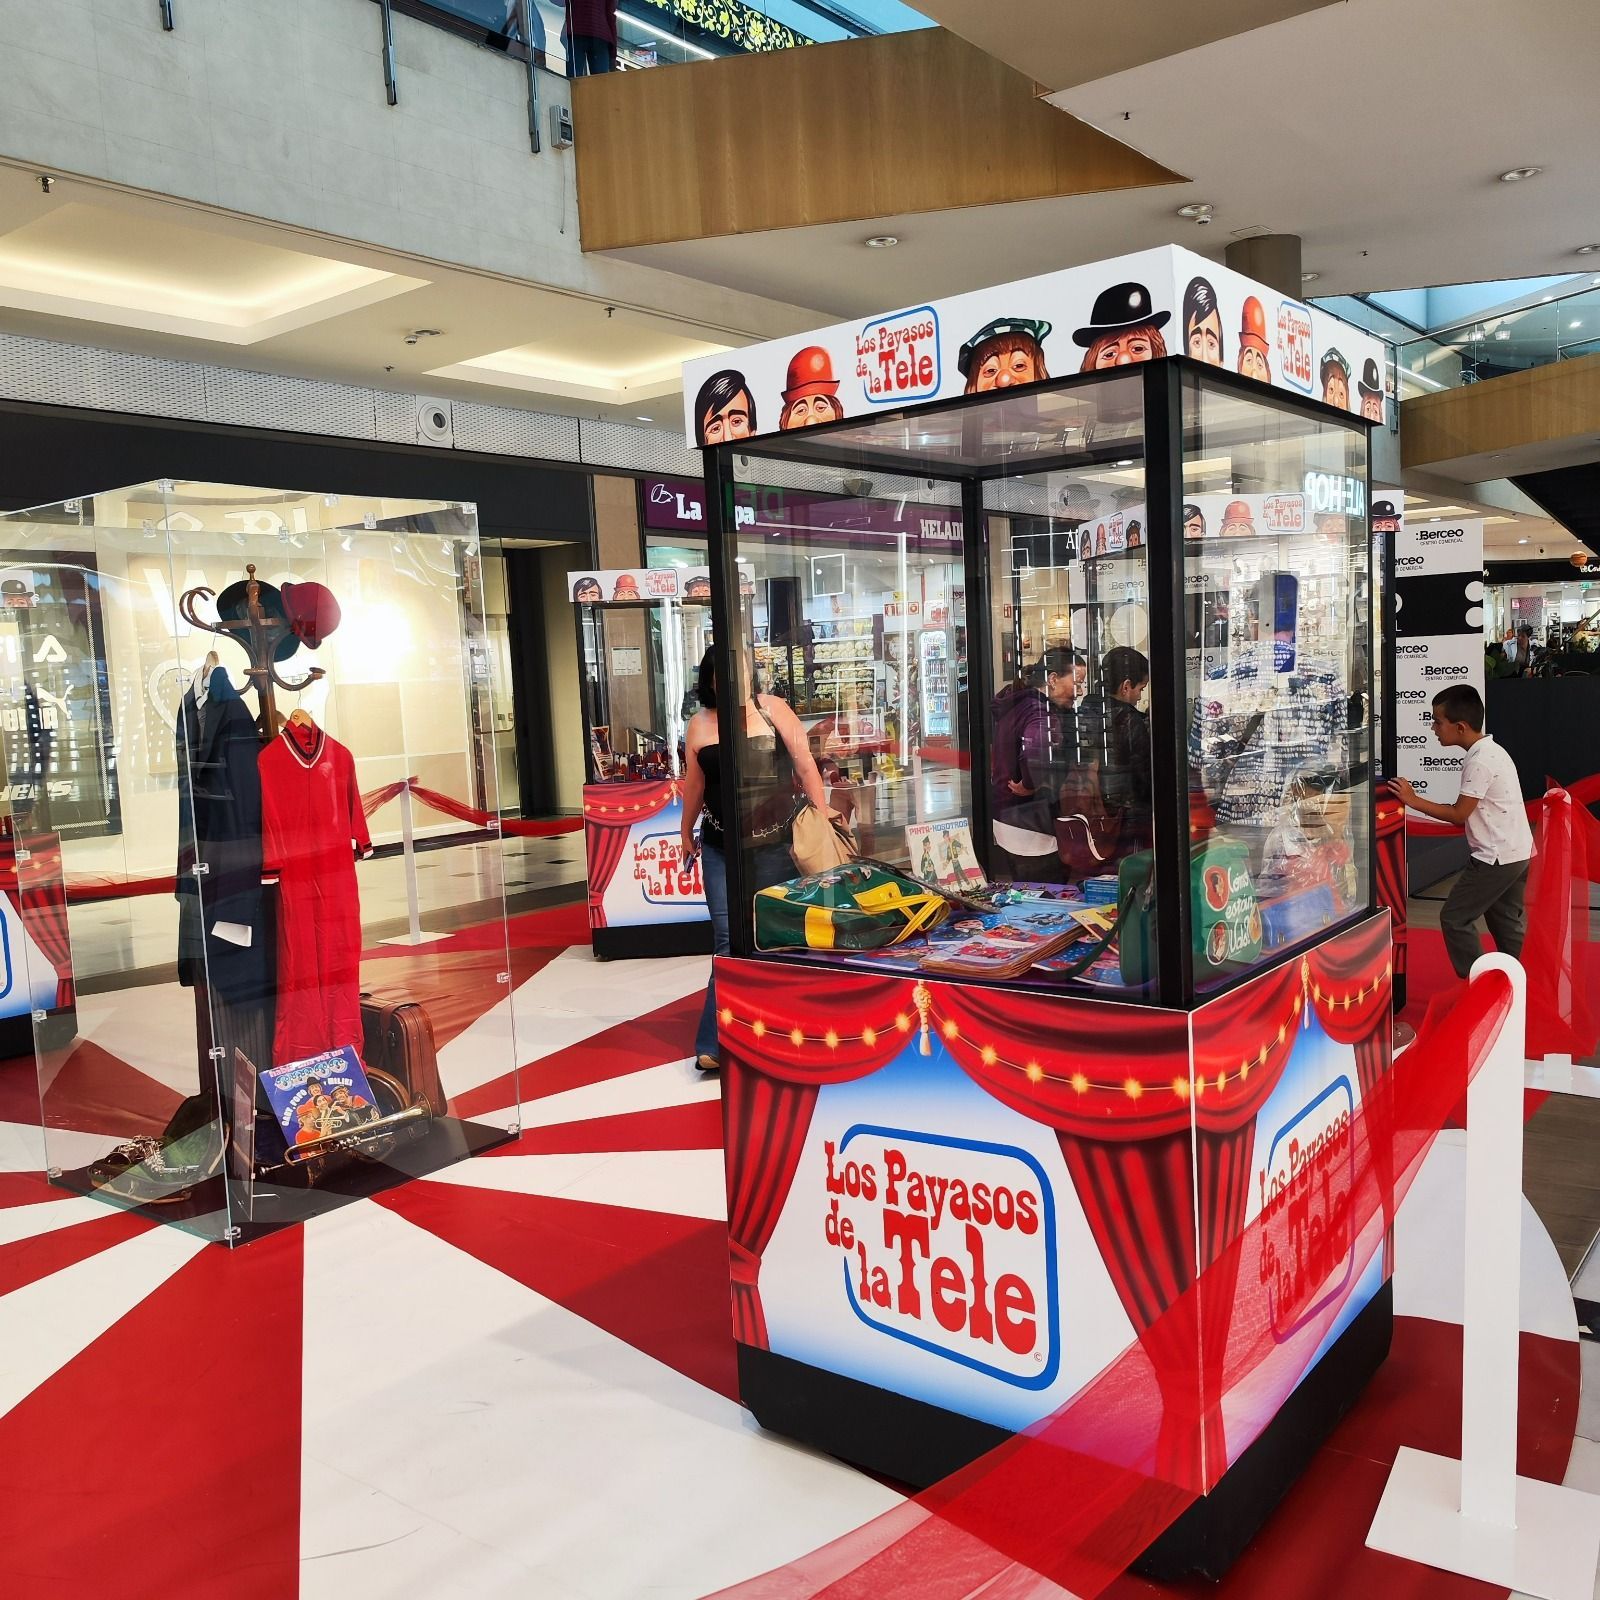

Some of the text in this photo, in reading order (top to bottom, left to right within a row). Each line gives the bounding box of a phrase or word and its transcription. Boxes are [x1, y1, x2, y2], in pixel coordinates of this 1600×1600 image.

[856, 321, 934, 355] Los Payasos
[1288, 333, 1311, 382] Tele
[856, 358, 868, 377] de
[869, 343, 933, 393] la Tele
[675, 493, 703, 520] La
[1275, 507, 1302, 527] Tele
[654, 579, 676, 593] Tele
[634, 843, 656, 862] Los
[634, 863, 647, 879] de
[648, 859, 703, 896] la Tel
[824, 1140, 1039, 1235] Los Payasos
[1259, 1109, 1349, 1226] Los Payasos
[824, 1197, 855, 1250] de
[1259, 1231, 1275, 1284] de
[1276, 1170, 1349, 1323] la Tele
[857, 1207, 1037, 1355] la Tele
